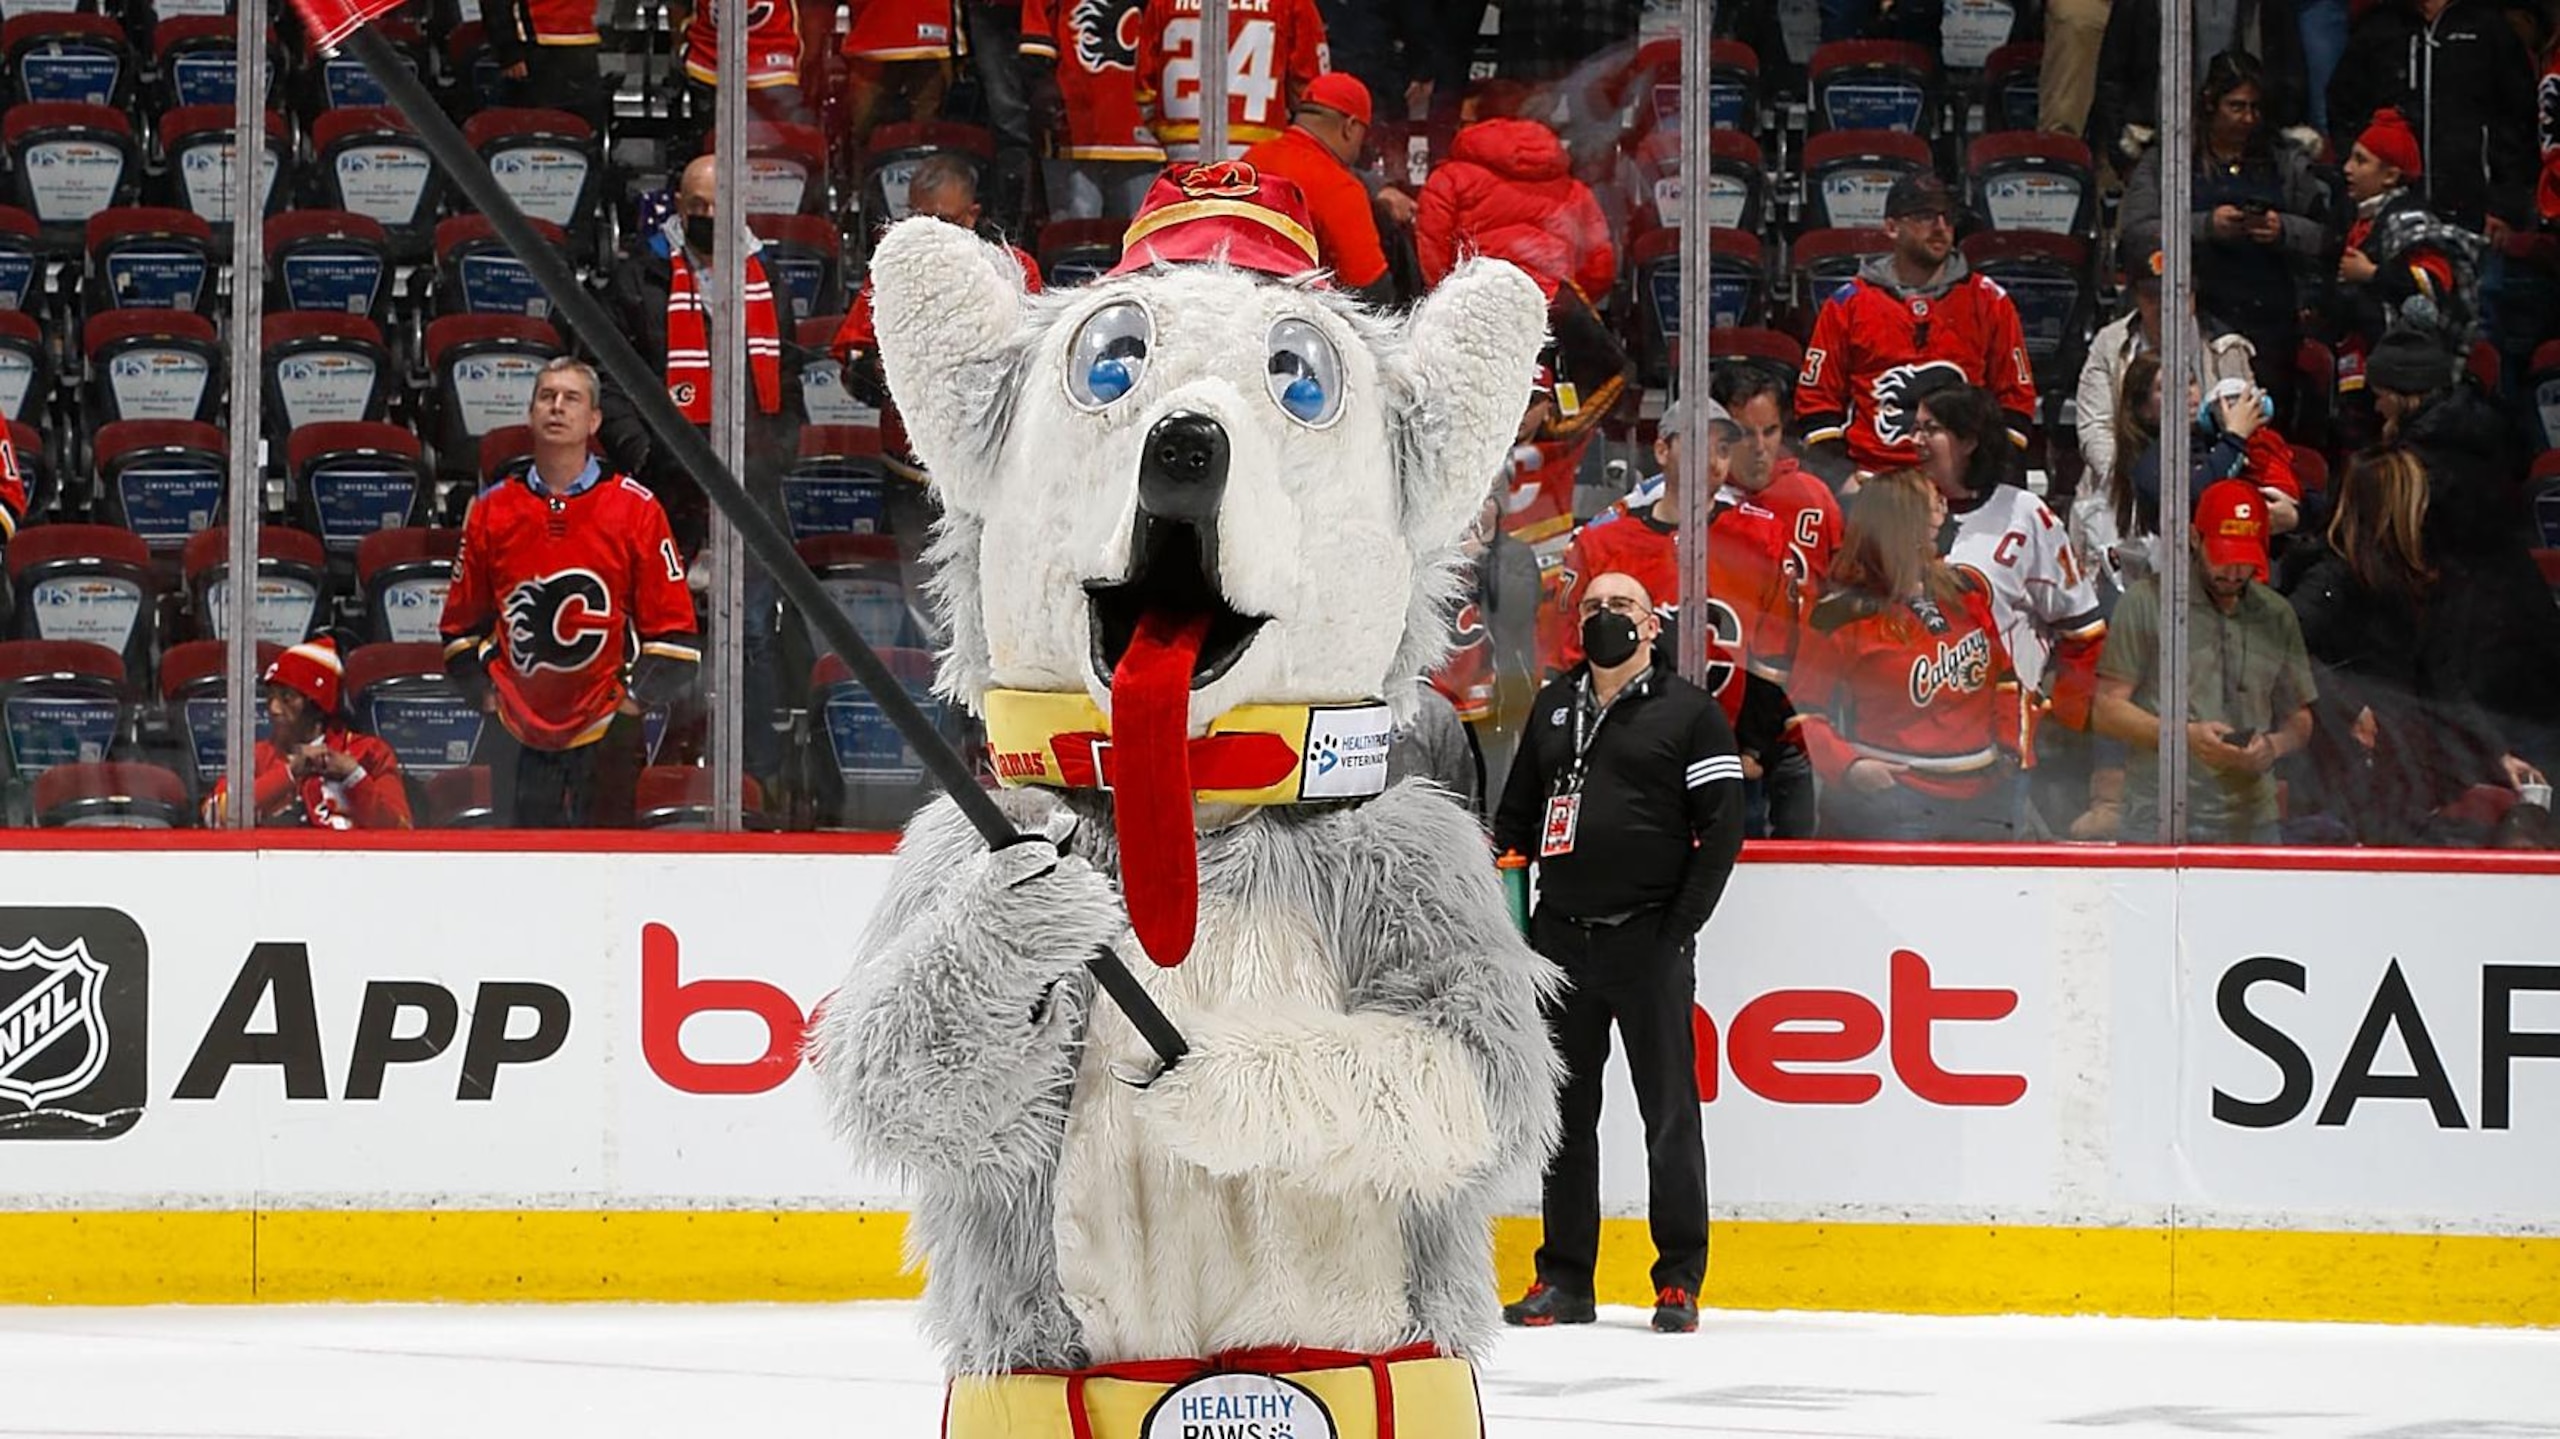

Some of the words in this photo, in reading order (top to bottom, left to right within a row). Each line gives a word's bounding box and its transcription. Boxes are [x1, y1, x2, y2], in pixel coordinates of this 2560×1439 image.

[1163, 18, 1278, 122] 24
[1799, 348, 1827, 386] 3
[1795, 508, 1824, 547] C
[660, 538, 685, 581] 1
[1993, 531, 2027, 568] C
[1909, 628, 1989, 708] Calgary
[1182, 1394, 1294, 1420] HEALTHY
